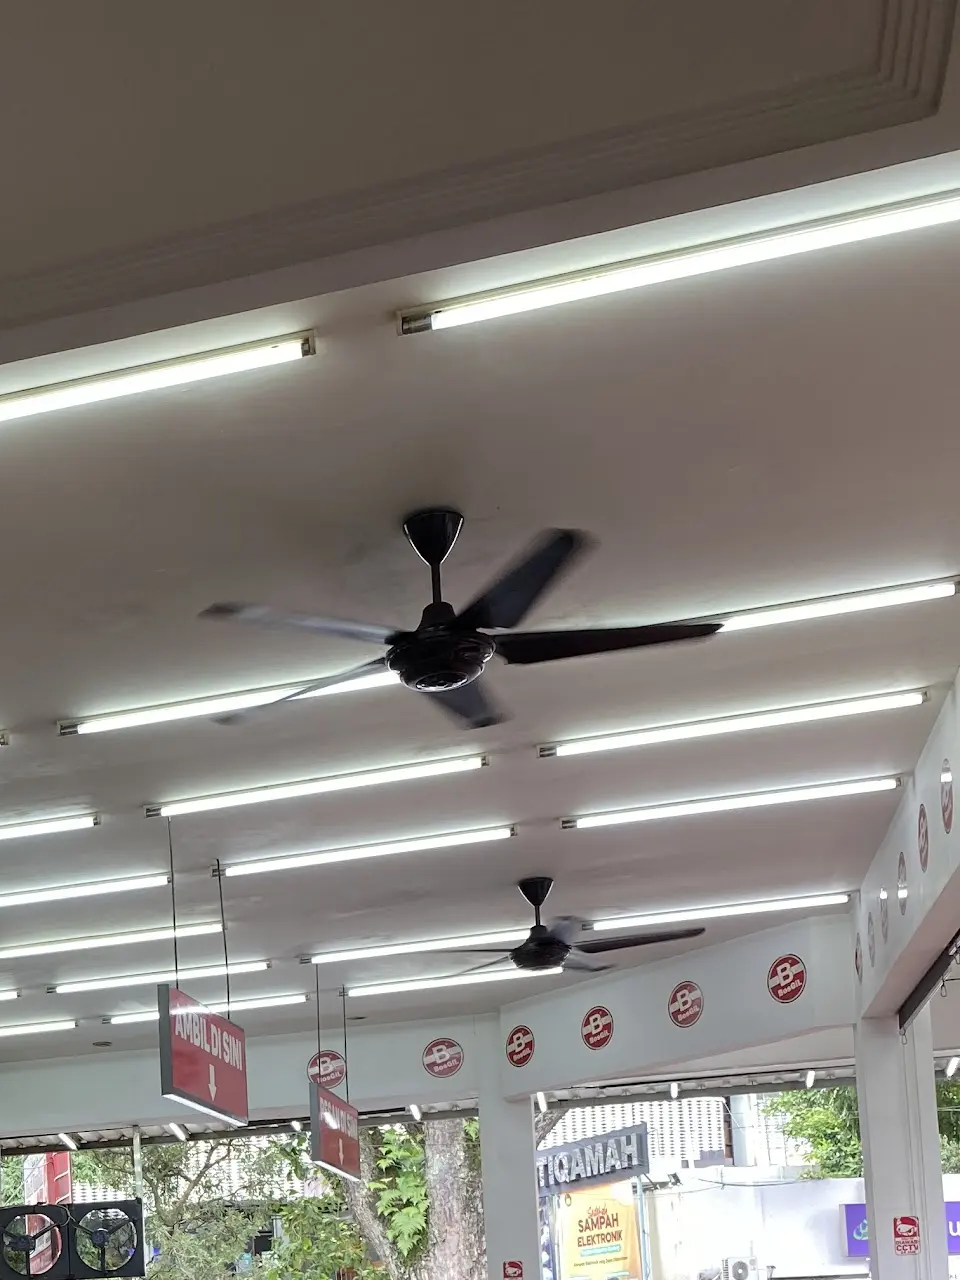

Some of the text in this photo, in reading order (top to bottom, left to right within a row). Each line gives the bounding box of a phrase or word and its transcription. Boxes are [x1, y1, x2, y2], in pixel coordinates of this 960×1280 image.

[776, 962, 794, 986] B
[676, 990, 692, 1012] B
[590, 1014, 602, 1034] B
[175, 1007, 242, 1070] AMBIL DI SINI
[512, 1032, 525, 1052] B
[432, 1044, 450, 1064] B
[578, 1213, 619, 1233] SAMPAH
[578, 1230, 622, 1247] ELEKTRONIK
